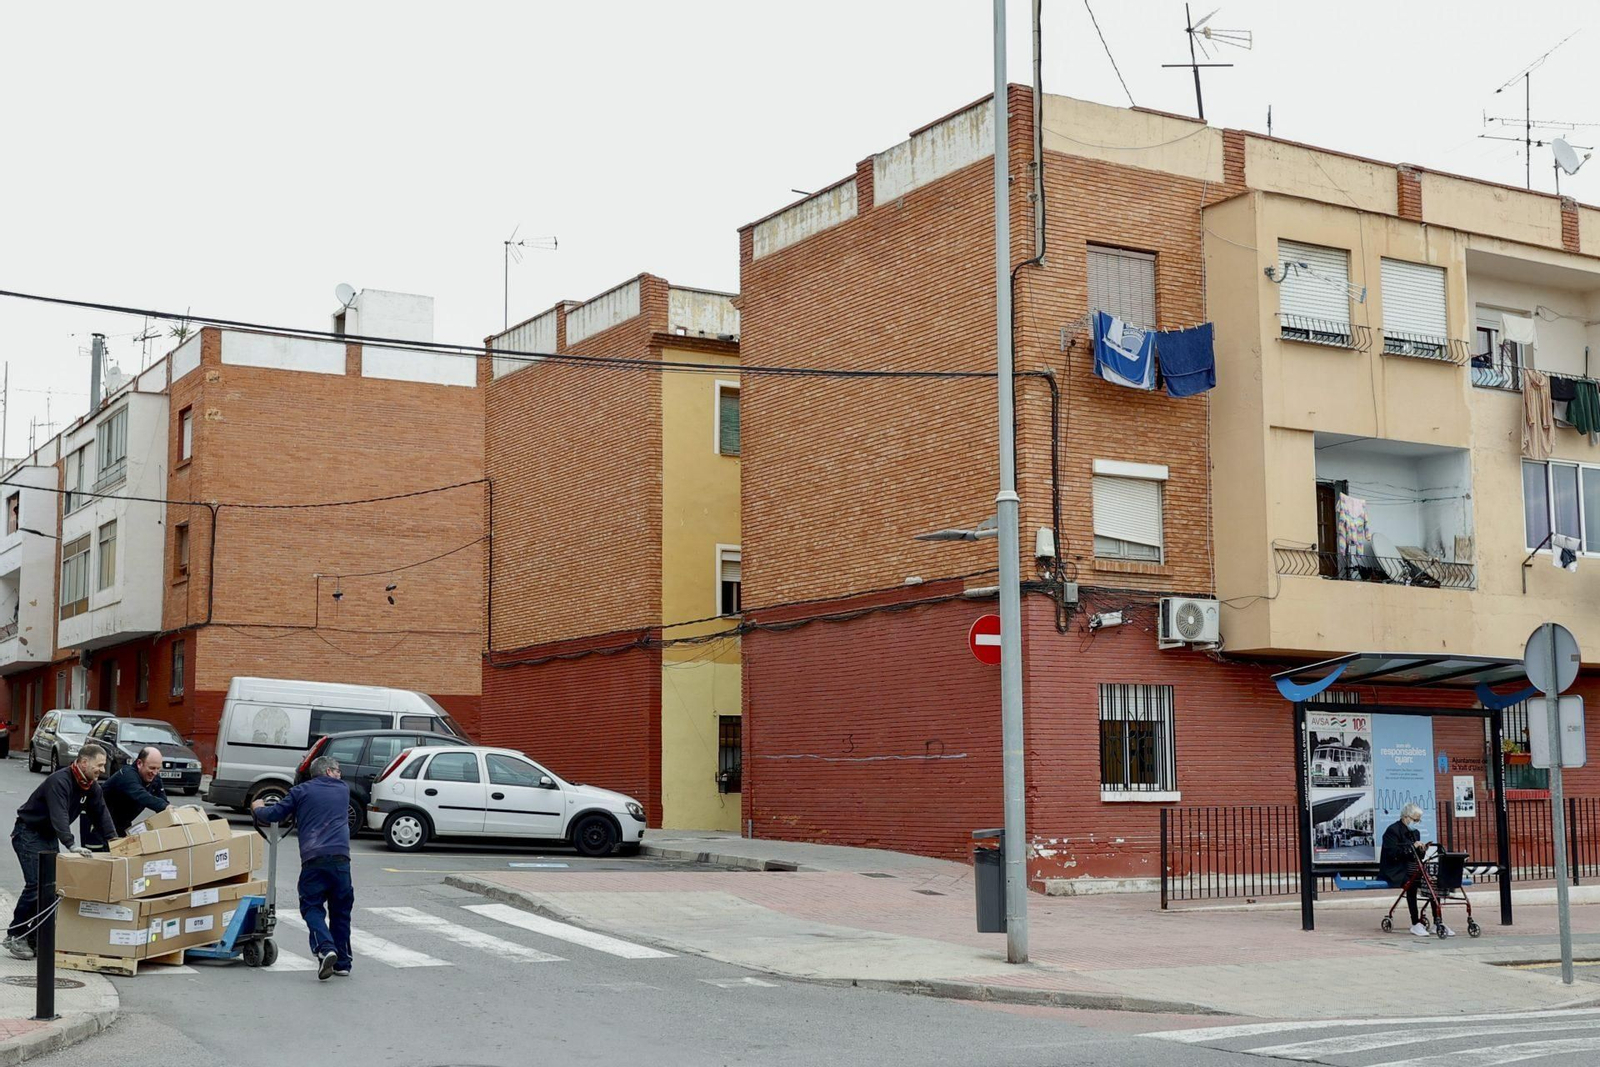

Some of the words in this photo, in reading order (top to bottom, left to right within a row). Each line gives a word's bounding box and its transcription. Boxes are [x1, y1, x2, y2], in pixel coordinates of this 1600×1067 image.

[1311, 717, 1329, 726] AVSA
[1352, 718, 1366, 731] 100
[1380, 747, 1426, 758] responsables
[216, 852, 227, 862] OTIS
